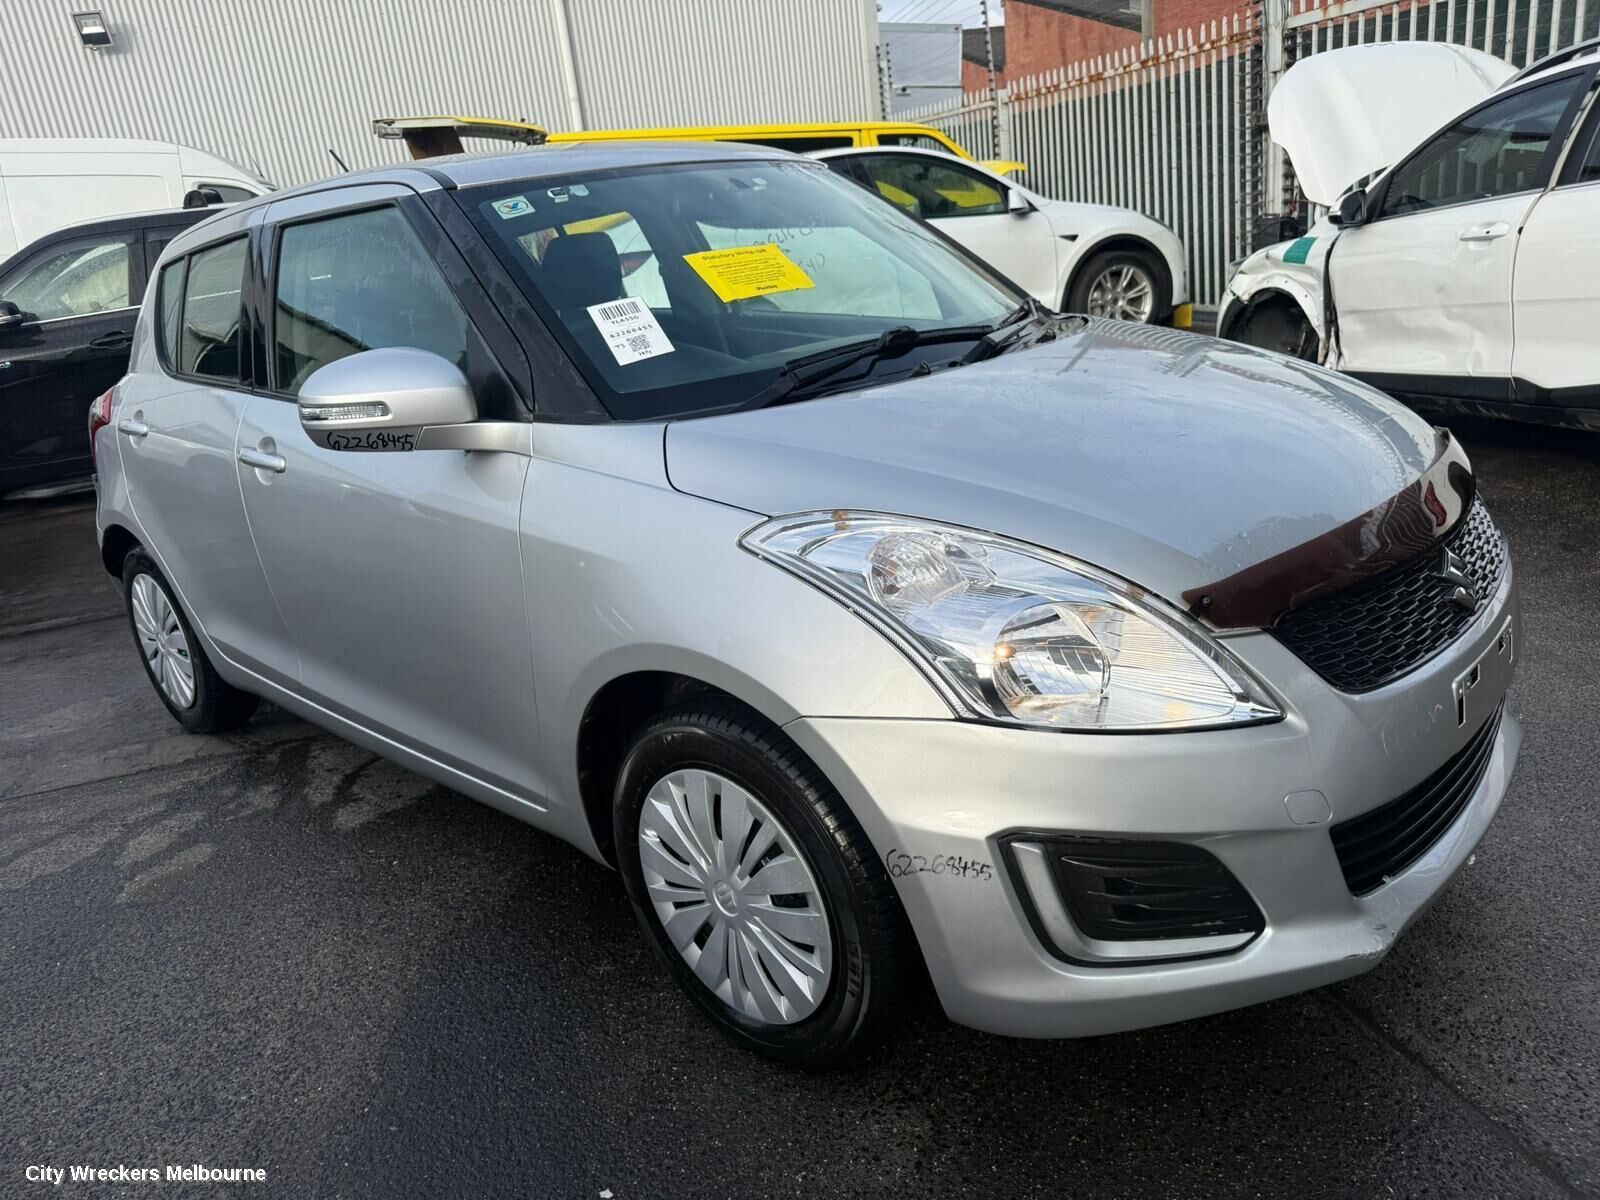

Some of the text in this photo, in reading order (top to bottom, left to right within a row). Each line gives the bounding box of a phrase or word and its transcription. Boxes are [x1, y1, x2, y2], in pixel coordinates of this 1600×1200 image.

[609, 323, 653, 339] 62268455
[326, 431, 415, 451] 62268455
[886, 848, 994, 881] 62268455
